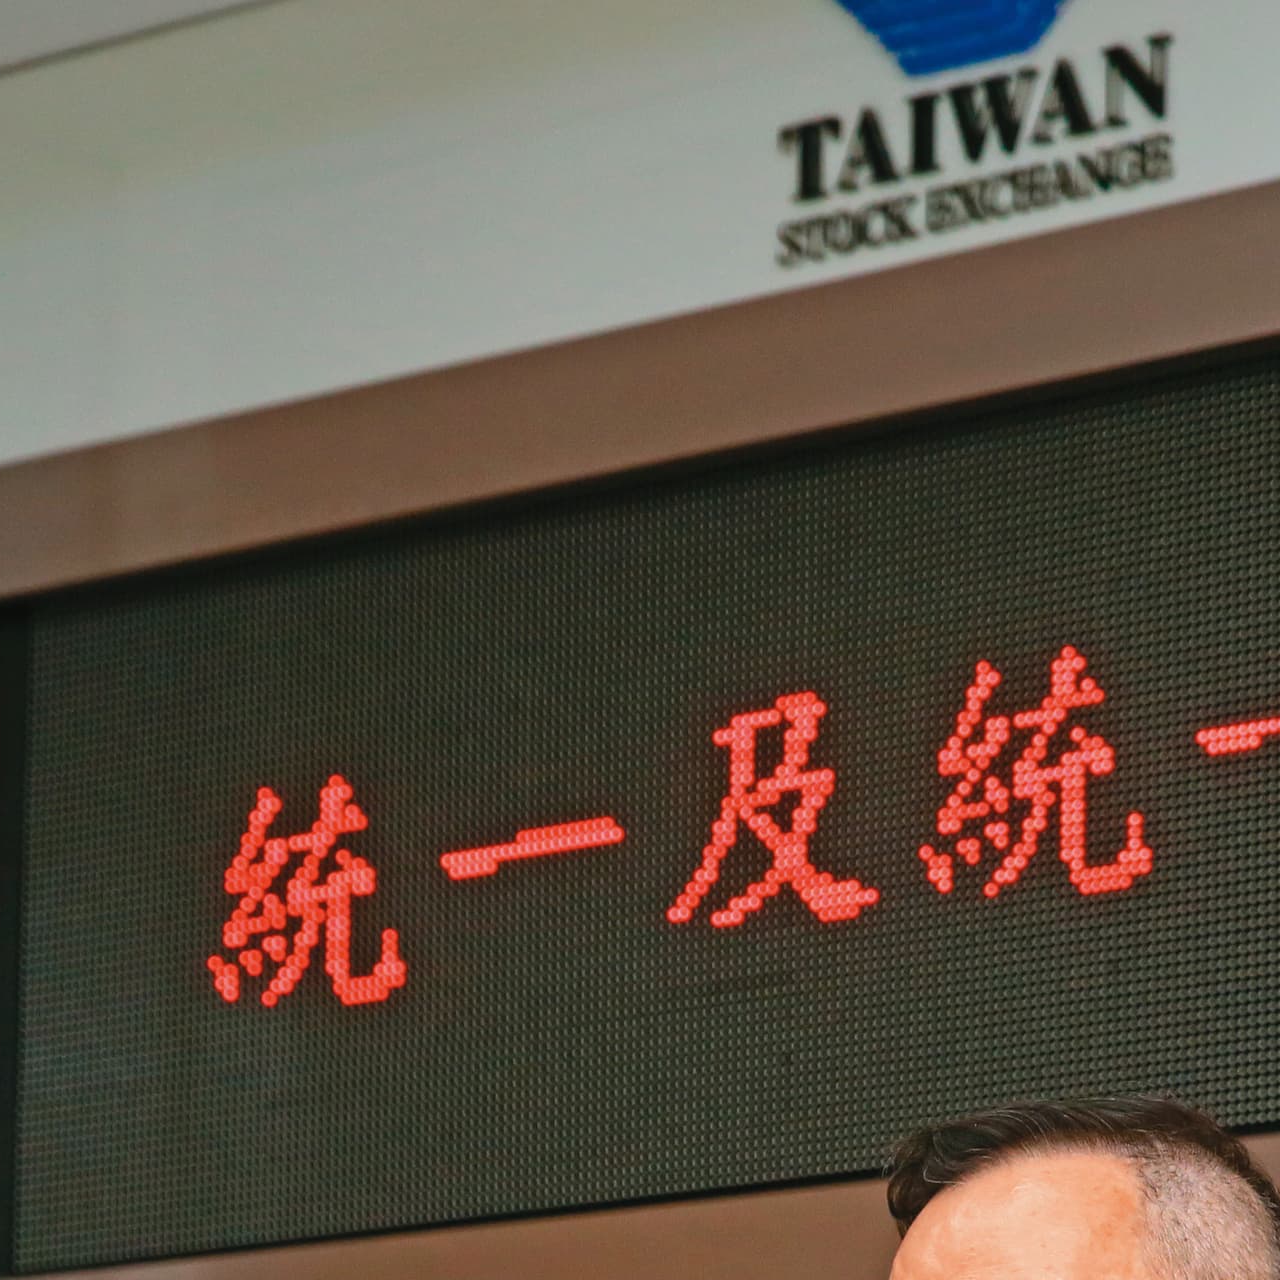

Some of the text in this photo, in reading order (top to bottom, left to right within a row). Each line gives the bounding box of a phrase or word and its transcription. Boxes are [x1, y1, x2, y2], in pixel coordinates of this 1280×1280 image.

[776, 31, 1175, 203] TAIWAN
[776, 131, 1175, 269] STOCK EXCHANGE
